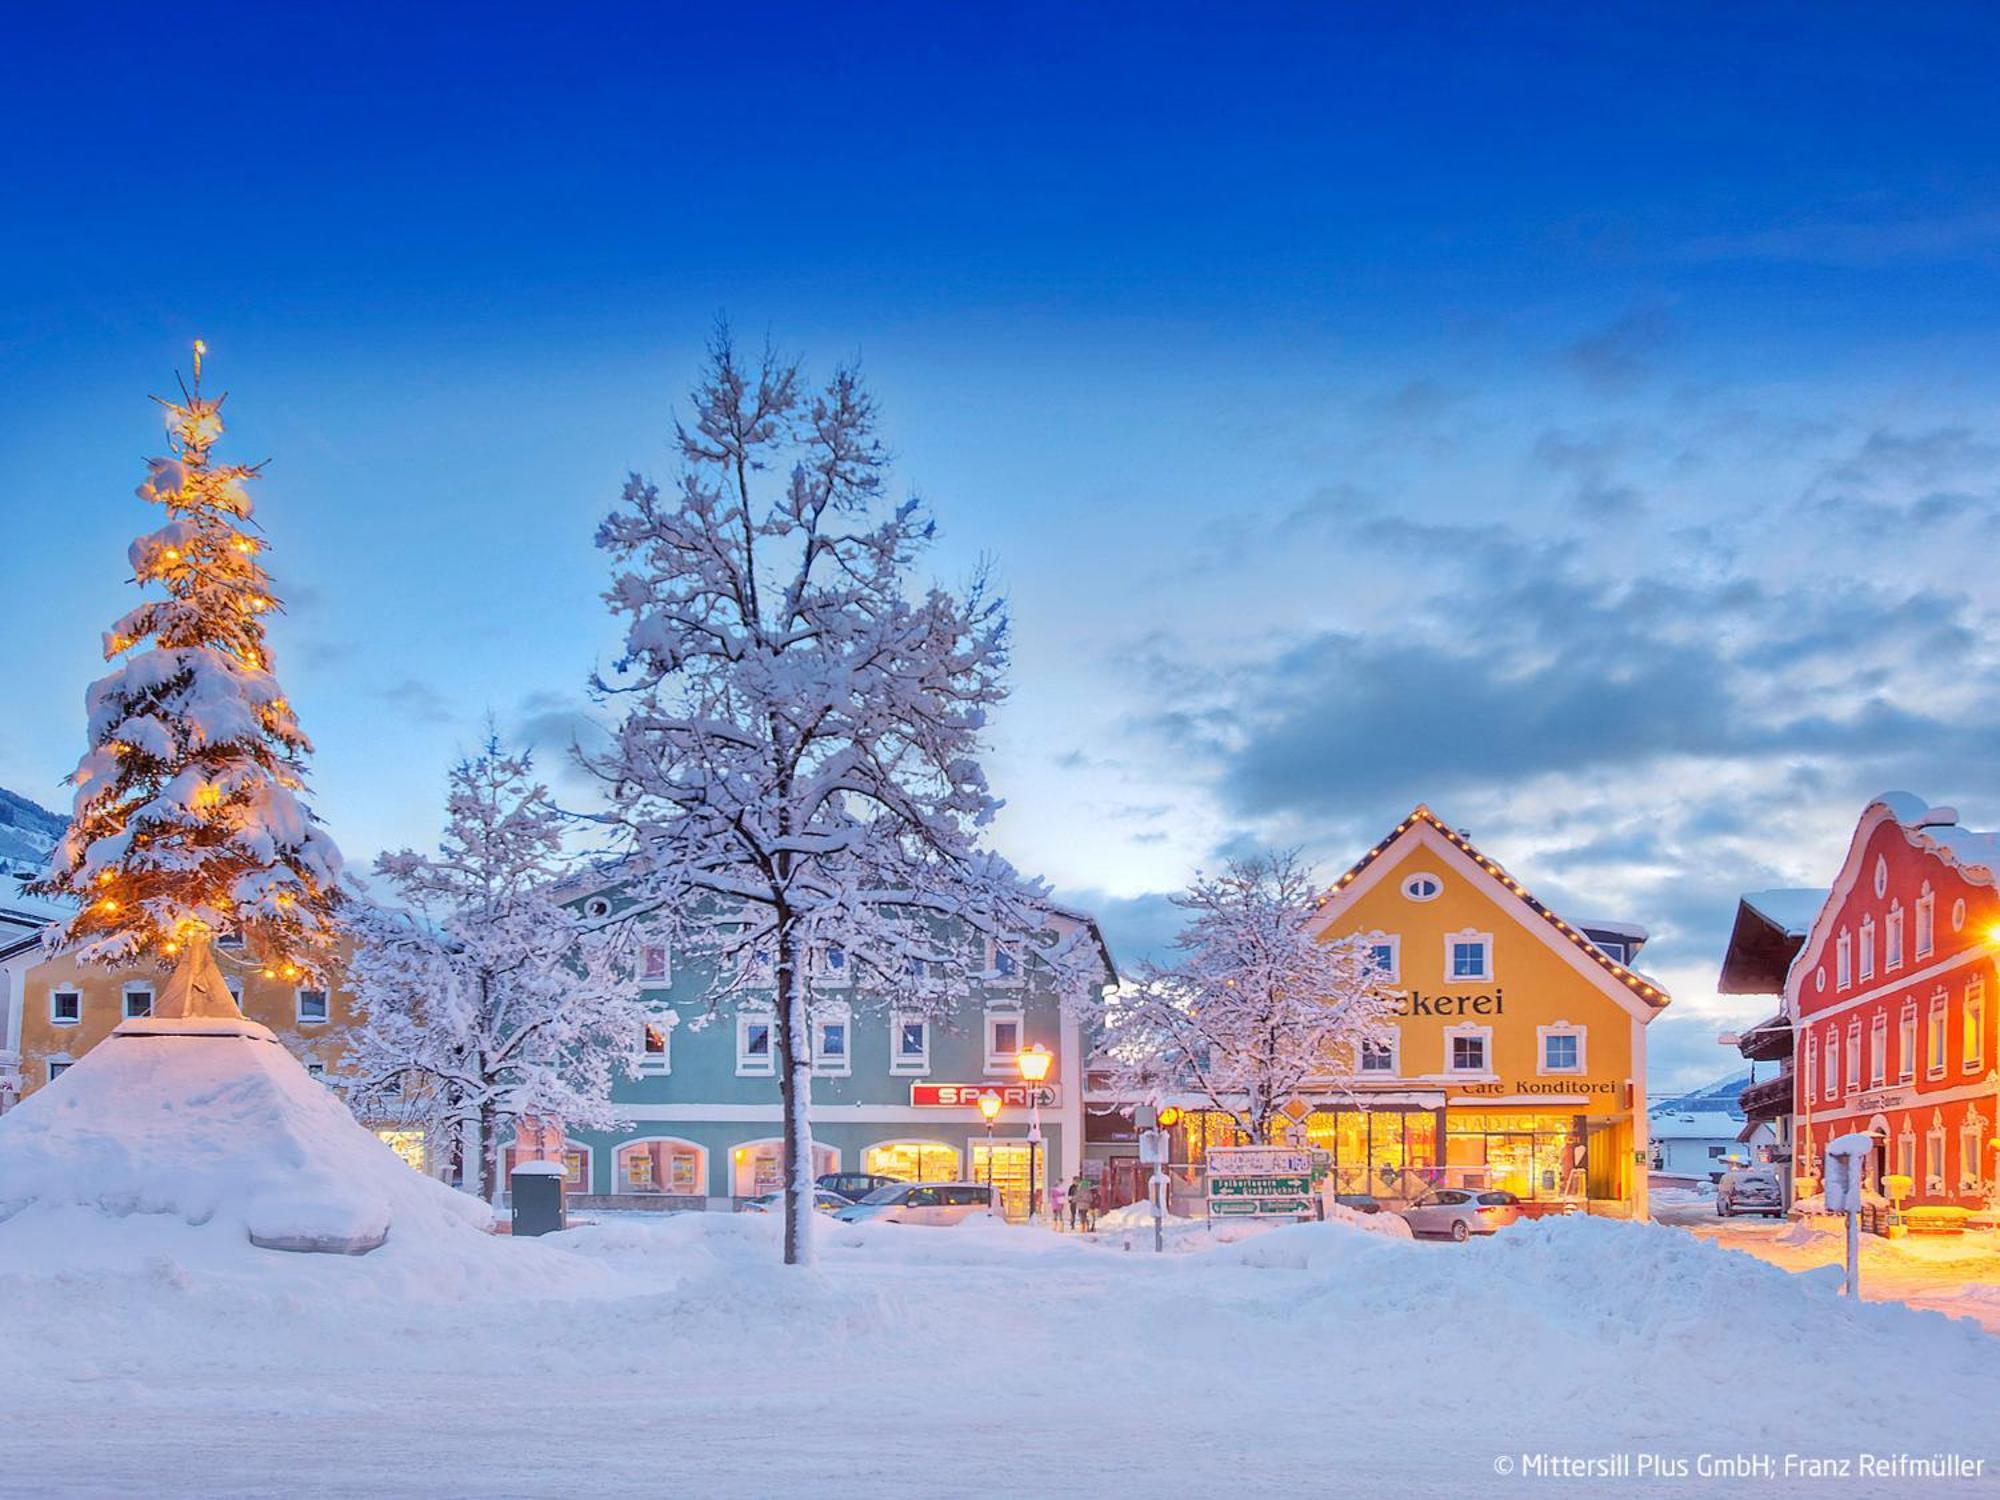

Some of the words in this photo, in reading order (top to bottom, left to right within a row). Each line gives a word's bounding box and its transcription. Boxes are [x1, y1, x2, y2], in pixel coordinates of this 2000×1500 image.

[1375, 988, 1503, 1016] ckerei
[938, 1087, 1025, 1104] SPR
[1516, 1081, 1616, 1094] Konditorei
